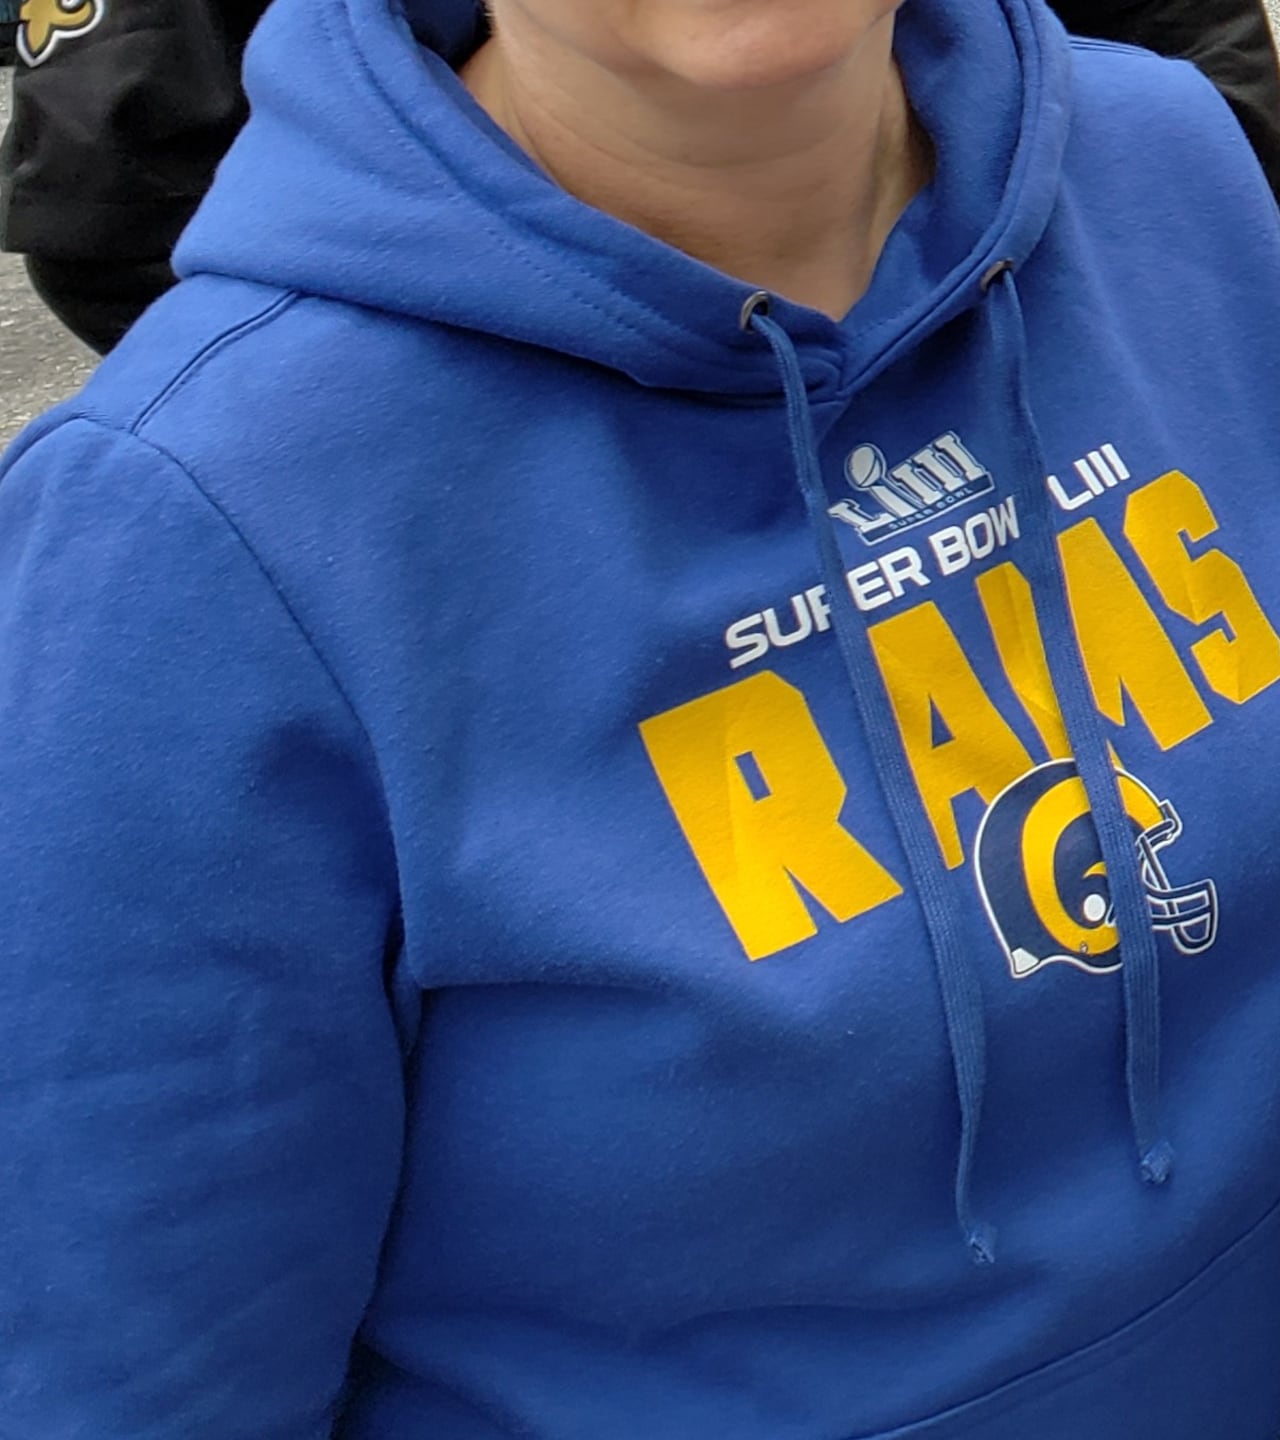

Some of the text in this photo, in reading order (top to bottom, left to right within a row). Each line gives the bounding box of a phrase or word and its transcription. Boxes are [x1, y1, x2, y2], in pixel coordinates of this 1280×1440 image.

[888, 485, 974, 530] SUPER BOWL
[927, 495, 1022, 577] BOW
[1046, 443, 1131, 511] LIII
